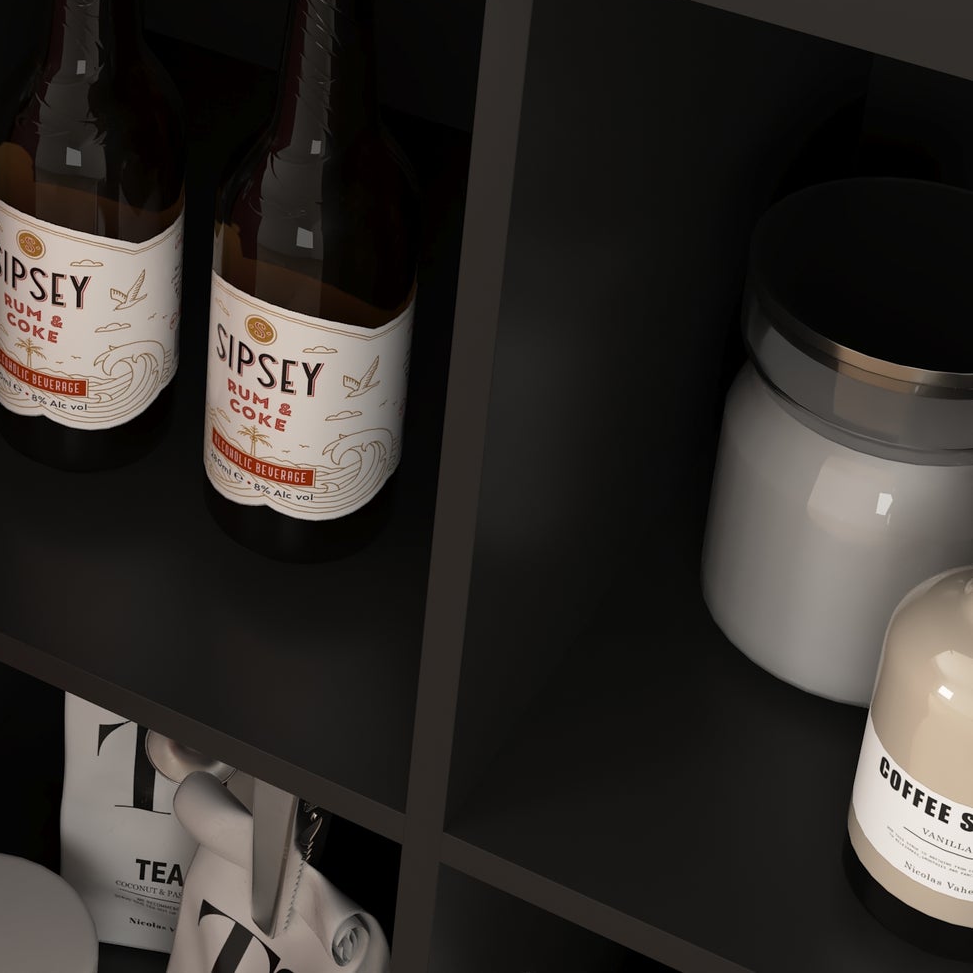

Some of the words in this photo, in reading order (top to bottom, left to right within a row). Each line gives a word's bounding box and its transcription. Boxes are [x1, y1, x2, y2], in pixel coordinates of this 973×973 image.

[4, 292, 42, 322] RUM
[51, 315, 63, 329] &
[6, 312, 59, 344] COKE
[216, 323, 325, 398] SIPSEY
[32, 373, 80, 394] BEVERAGE
[227, 378, 269, 409] RUM
[278, 402, 292, 417] &
[31, 394, 47, 405] 8%
[50, 400, 67, 409] Alc
[70, 403, 87, 411] vol
[229, 398, 287, 433] COKE
[214, 432, 253, 470] ALCOHOLIC
[256, 463, 307, 483] BEVERAGE
[253, 483, 271, 495] 8%
[273, 490, 291, 499] Alc
[296, 493, 314, 501] vol
[879, 756, 952, 824] COFFEE
[922, 827, 972, 854] VANILLA
[135, 858, 184, 887] TEA
[904, 860, 942, 886] Nicolas
[115, 880, 158, 896] COCONUT
